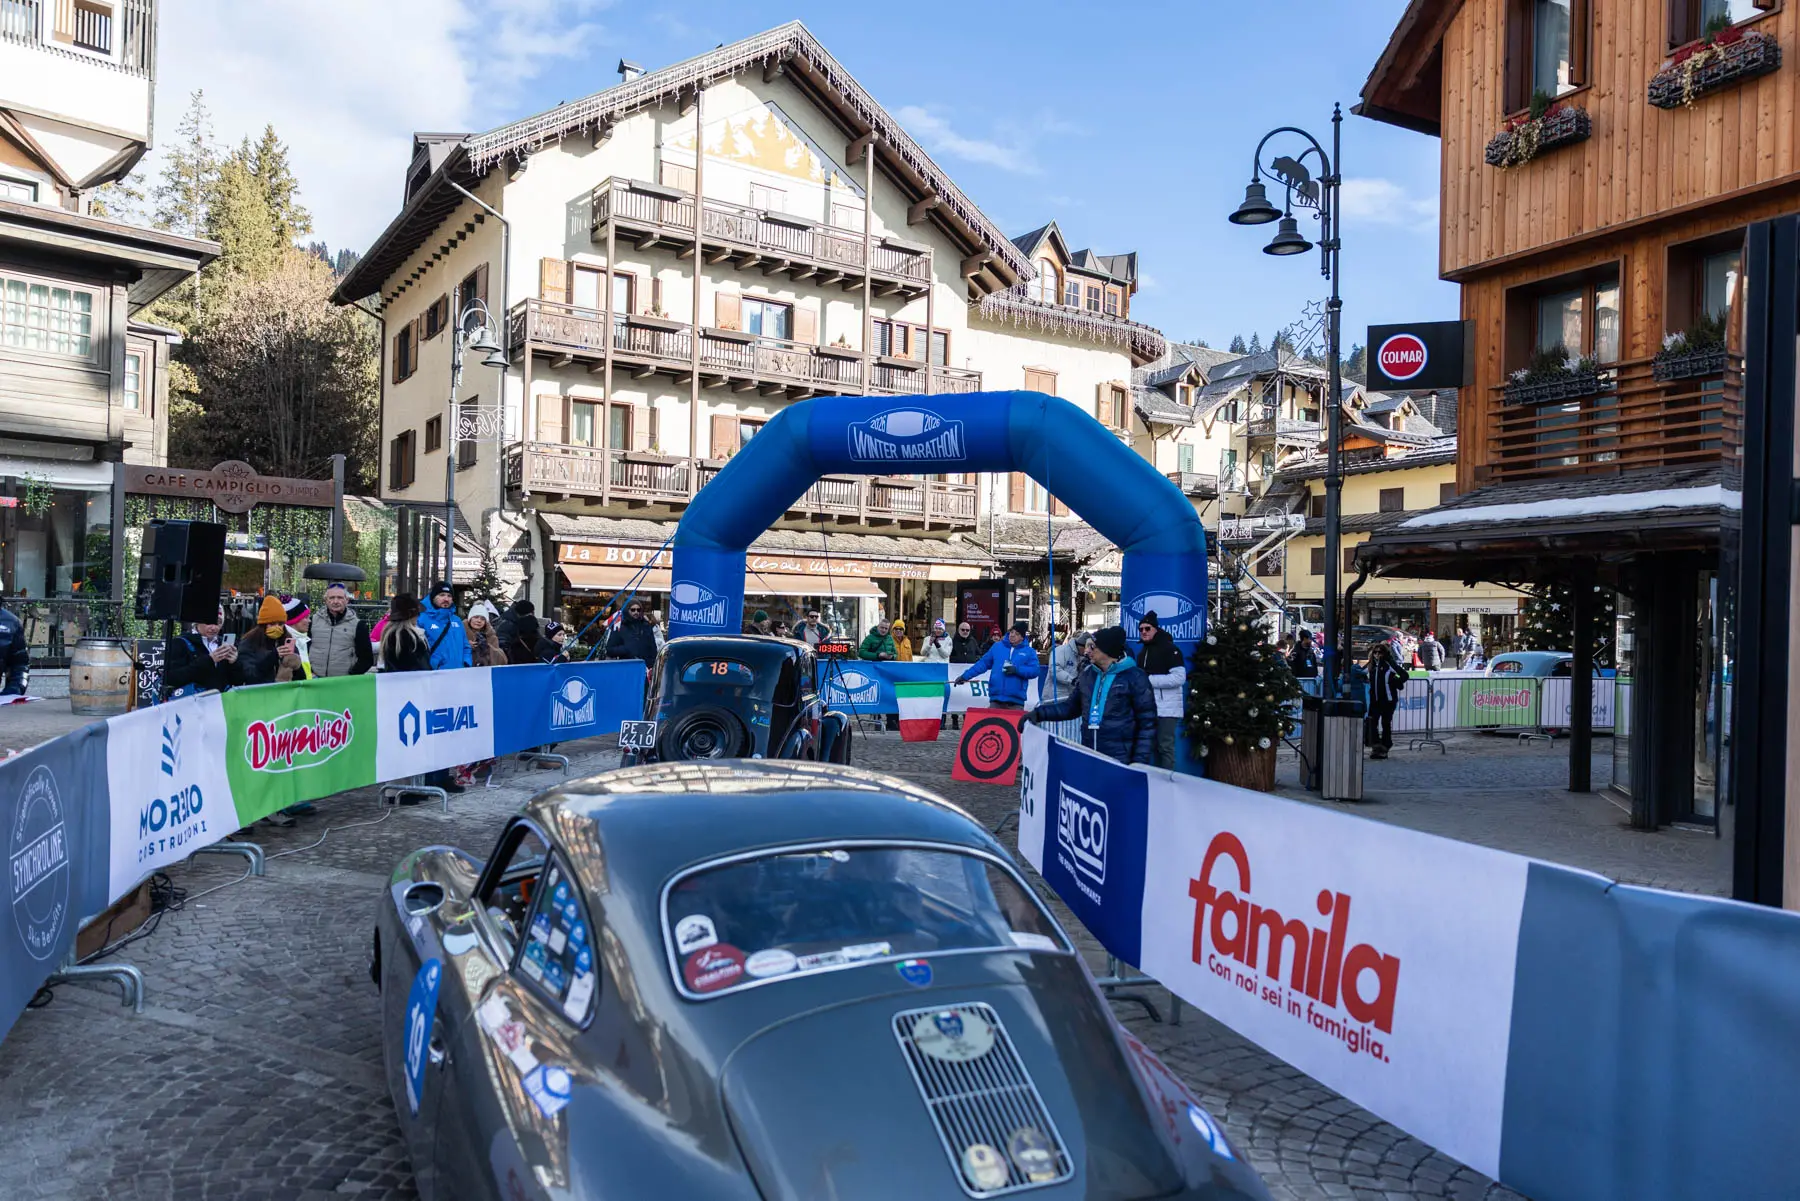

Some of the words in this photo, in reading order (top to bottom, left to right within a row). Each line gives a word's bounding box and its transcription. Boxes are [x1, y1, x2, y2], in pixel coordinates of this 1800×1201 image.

[1382, 350, 1422, 364] COLMAR
[870, 414, 887, 432] 2026
[924, 414, 940, 432] 2026
[854, 426, 898, 458] WINTER
[901, 425, 960, 458] MARATHON
[194, 478, 281, 494] CAMPIGLIO
[287, 485, 320, 497] JUMPER
[564, 545, 590, 560] La
[873, 561, 914, 570] SHOPPING
[700, 588, 712, 602] 2026
[680, 600, 725, 624] MARATHON
[1179, 598, 1192, 615] 2026
[710, 662, 728, 675] 18
[553, 695, 574, 726] WINTER
[426, 705, 478, 735] ISVAL
[622, 724, 638, 734] PE
[646, 724, 654, 734] 7
[622, 735, 653, 746] 4410
[14, 829, 64, 894] SYNCHROLINE
[28, 925, 40, 948] Skin
[1188, 831, 1400, 1034] famila
[1208, 954, 1231, 982] Con
[1236, 974, 1258, 996] noi
[1262, 986, 1282, 1008] sei
[1288, 991, 1301, 1018] in
[1307, 1002, 1390, 1064] famiglia.
[408, 1001, 426, 1079] 19
